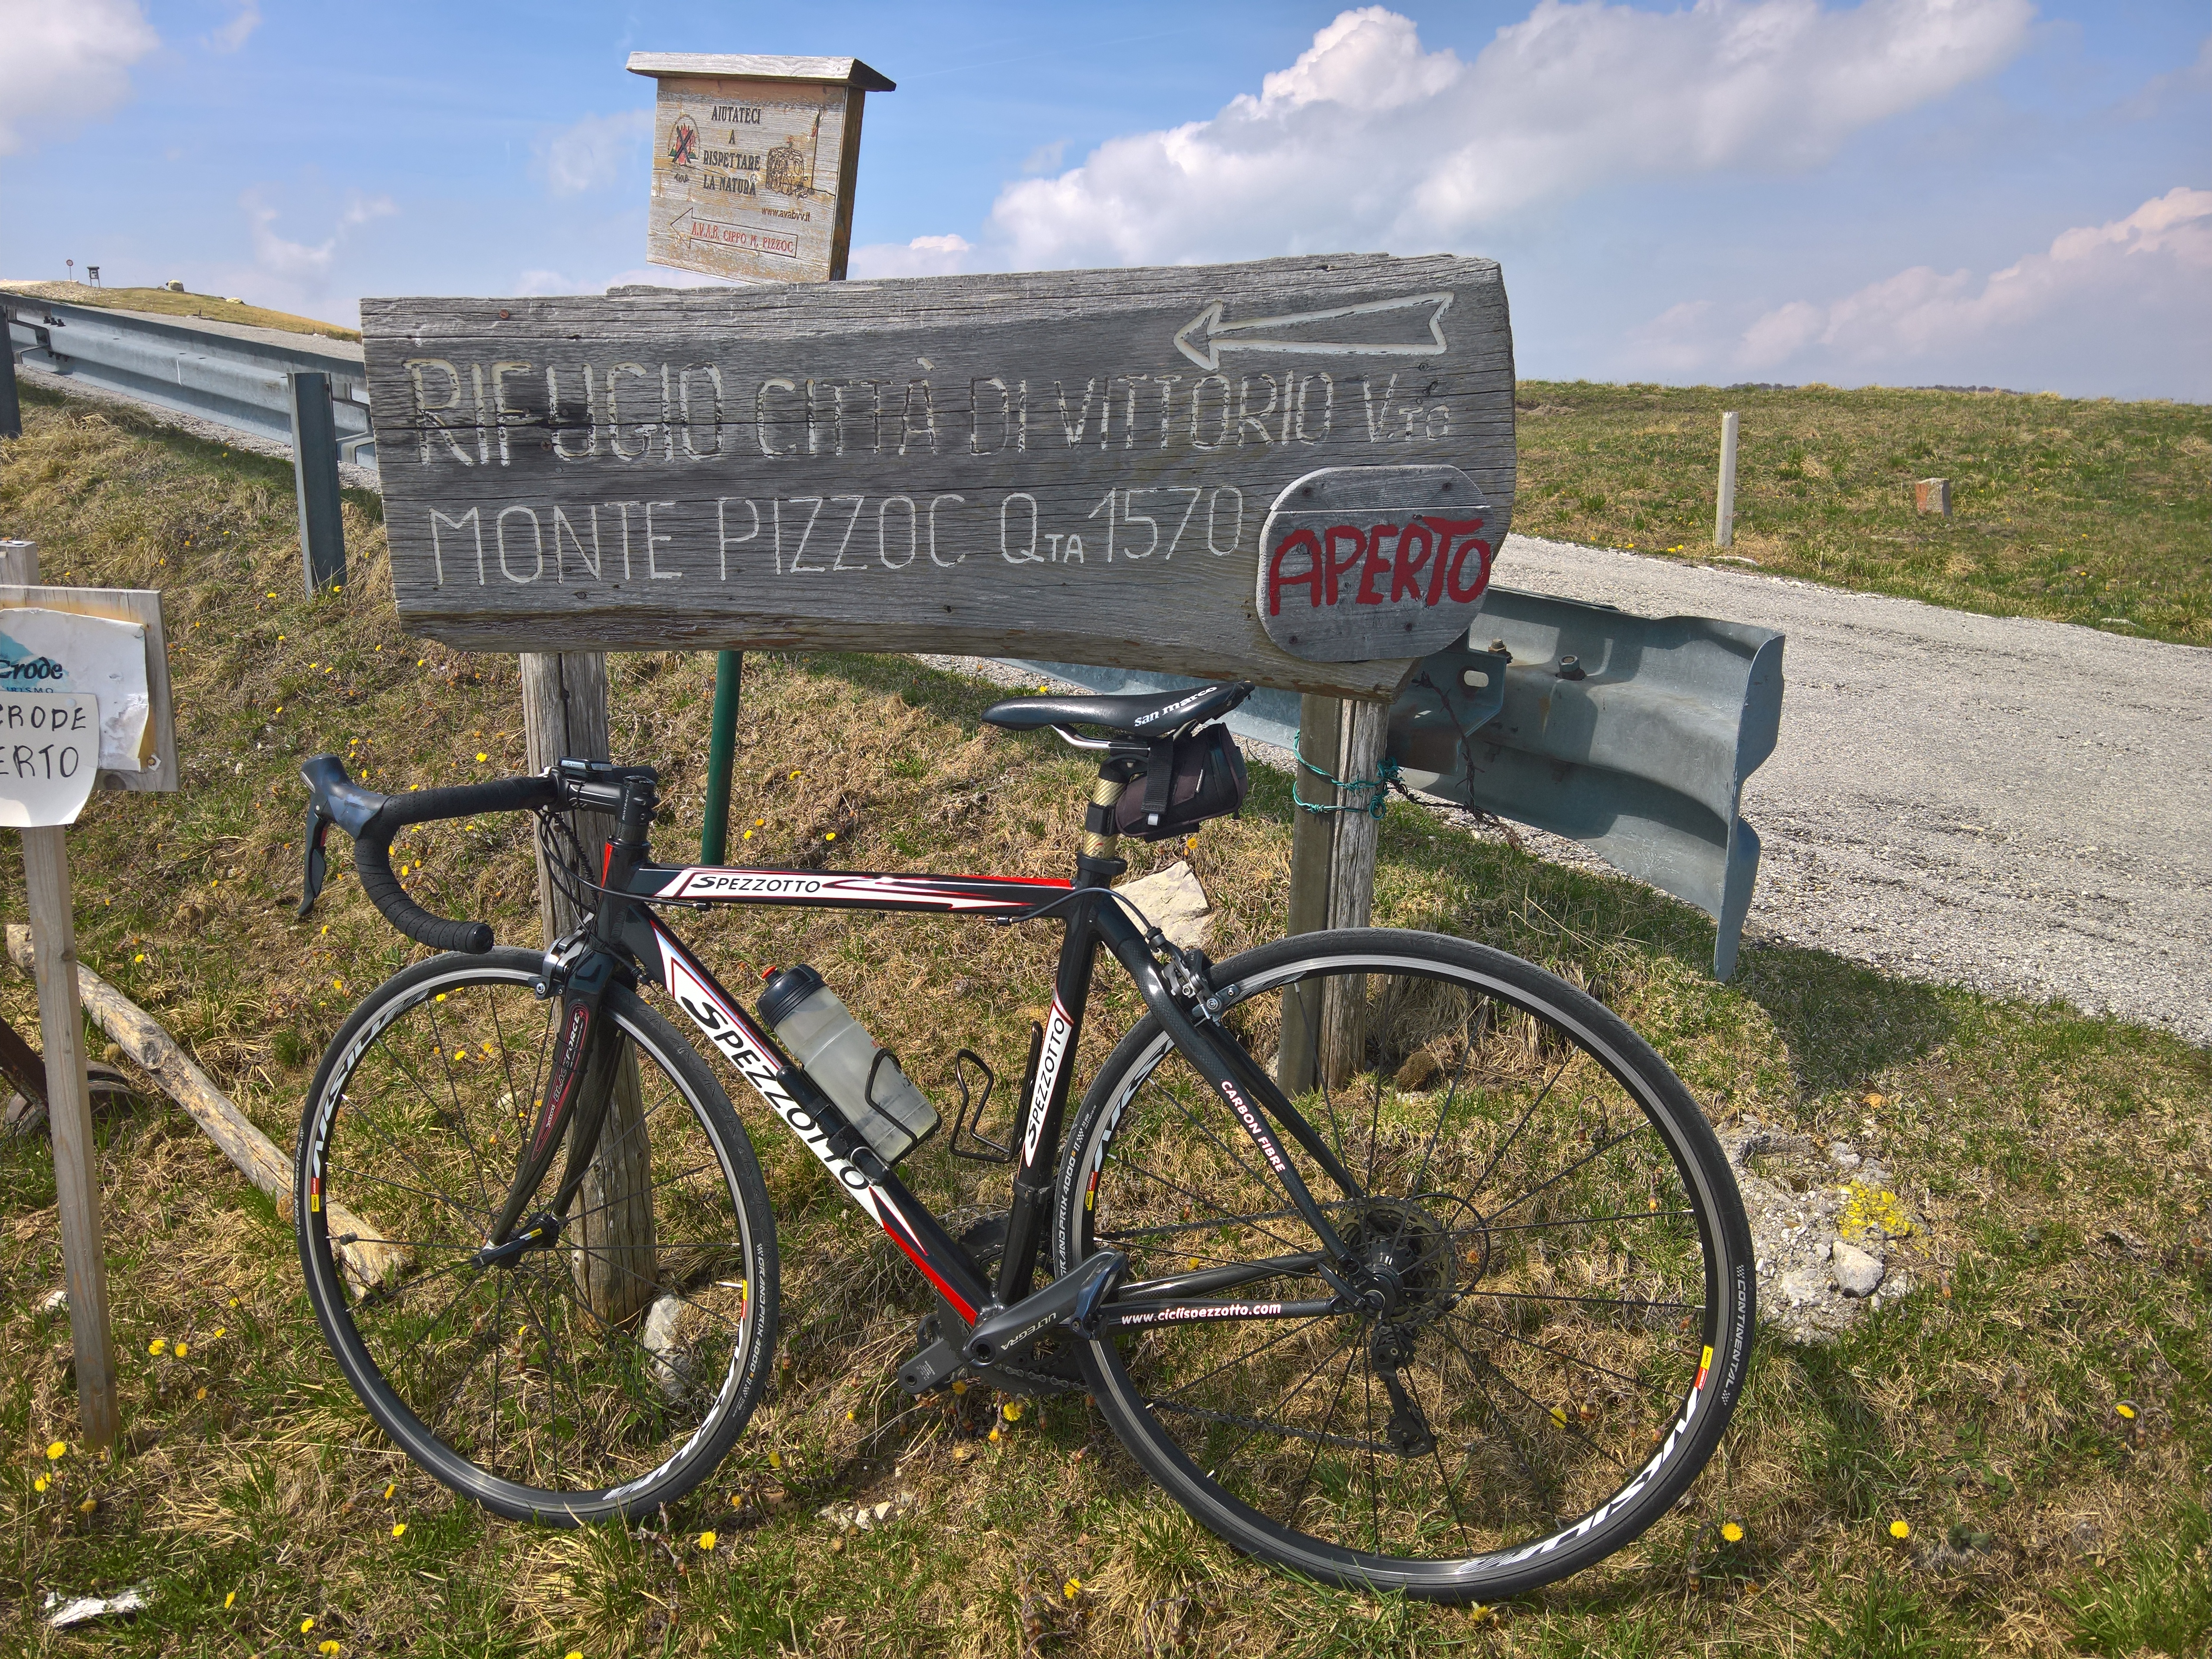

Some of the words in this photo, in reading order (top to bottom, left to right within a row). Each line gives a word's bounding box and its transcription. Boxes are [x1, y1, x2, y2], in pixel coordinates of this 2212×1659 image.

[711, 105, 761, 125] AIUTATECI
[728, 129, 736, 144] A
[703, 150, 761, 171] RISPETTARE
[703, 174, 715, 190] LA
[720, 176, 756, 195] NATURA
[723, 230, 746, 244] CIPPO
[763, 237, 793, 253] PIZZOC
[402, 358, 724, 466] RIFUGIO
[970, 377, 1027, 456] DI
[1054, 369, 1333, 450] VITTORIO
[428, 502, 684, 586] MONTE
[718, 494, 966, 581] PIZZOC
[1087, 486, 1243, 563] 1570
[1268, 516, 1492, 616] APERTO
[0, 704, 86, 732] RODE
[1134, 711, 1160, 727] san
[1162, 687, 1217, 716] marco
[690, 876, 821, 893] SPEZZOTTO
[1028, 1017, 1064, 1149] SPEZZOTTO
[1221, 1081, 1262, 1134] CARBON
[1258, 1136, 1286, 1172] FIBRE
[1001, 1312, 1056, 1350] ULTEGRA
[1725, 1278, 1746, 1393] CONTINENTAL
